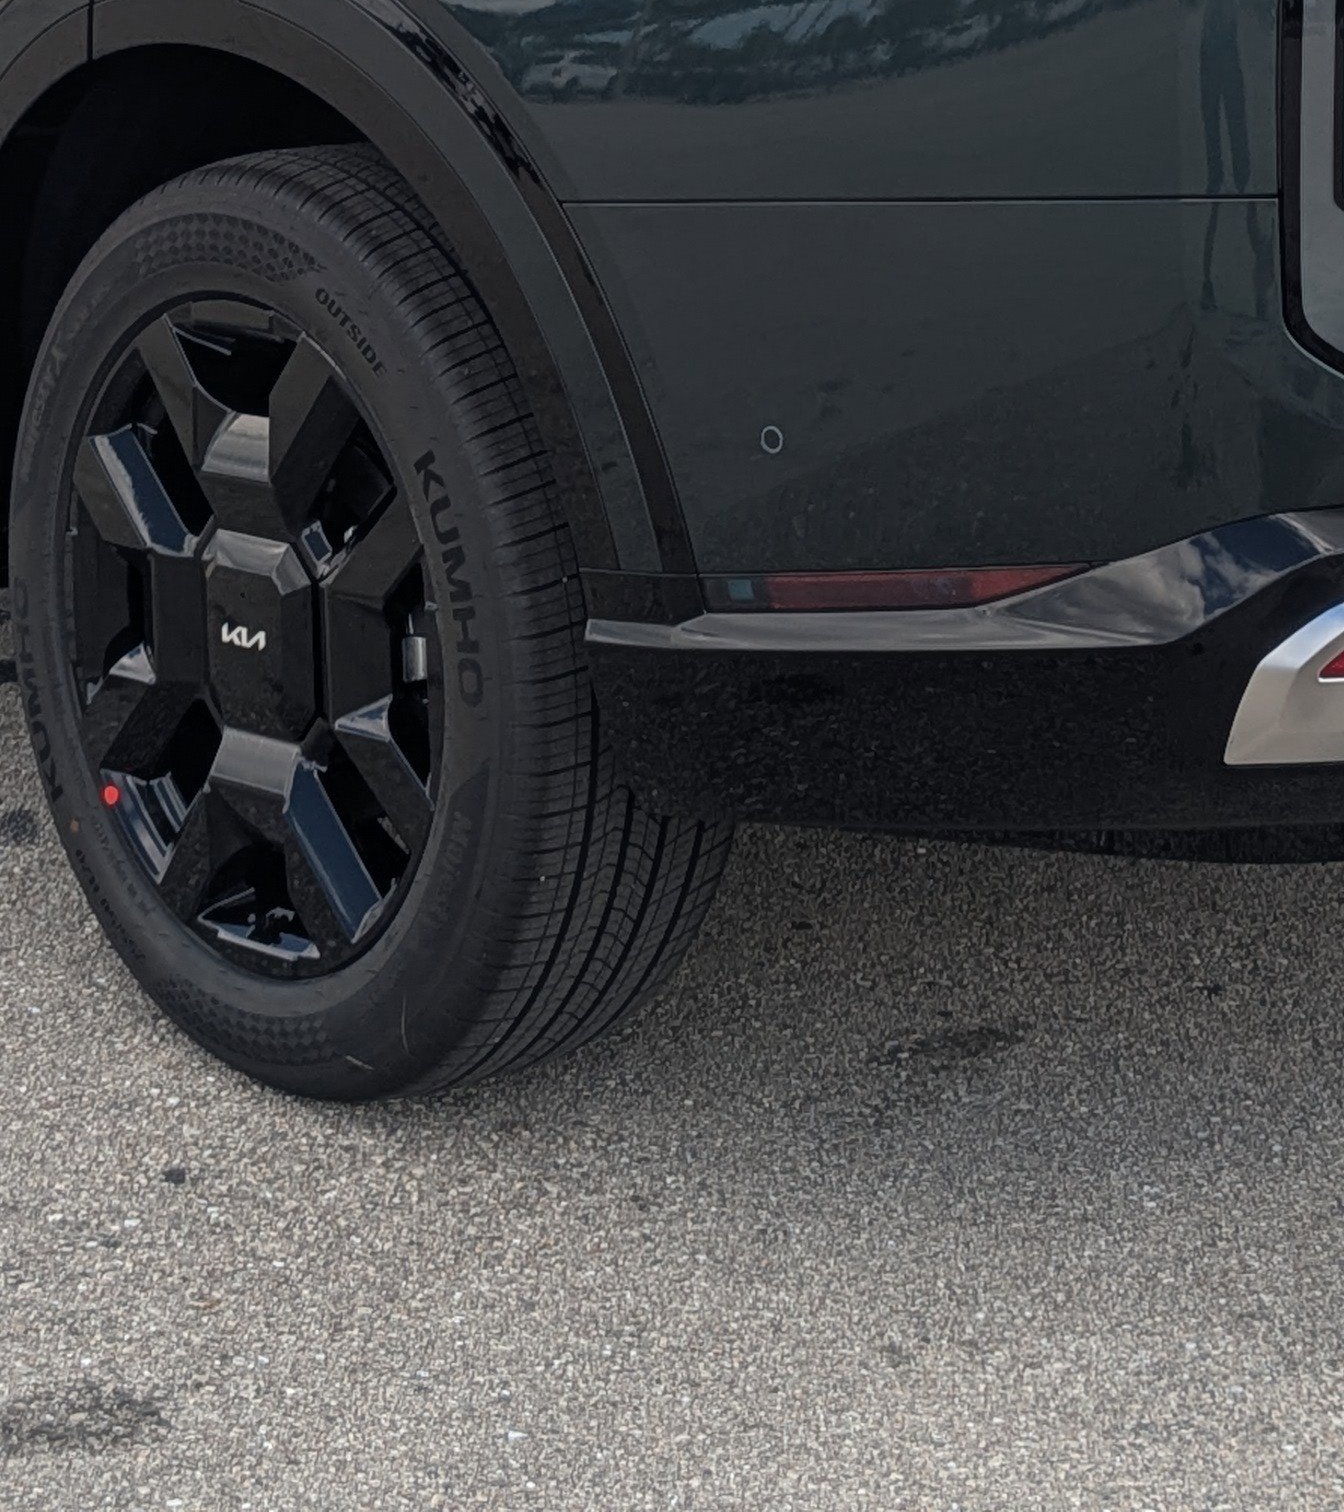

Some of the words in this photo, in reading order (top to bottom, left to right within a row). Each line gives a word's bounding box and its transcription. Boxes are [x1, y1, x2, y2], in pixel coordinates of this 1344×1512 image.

[314, 287, 388, 379] OUTSIDE
[413, 449, 484, 708] KUMHO
[221, 621, 266, 651] KIA
